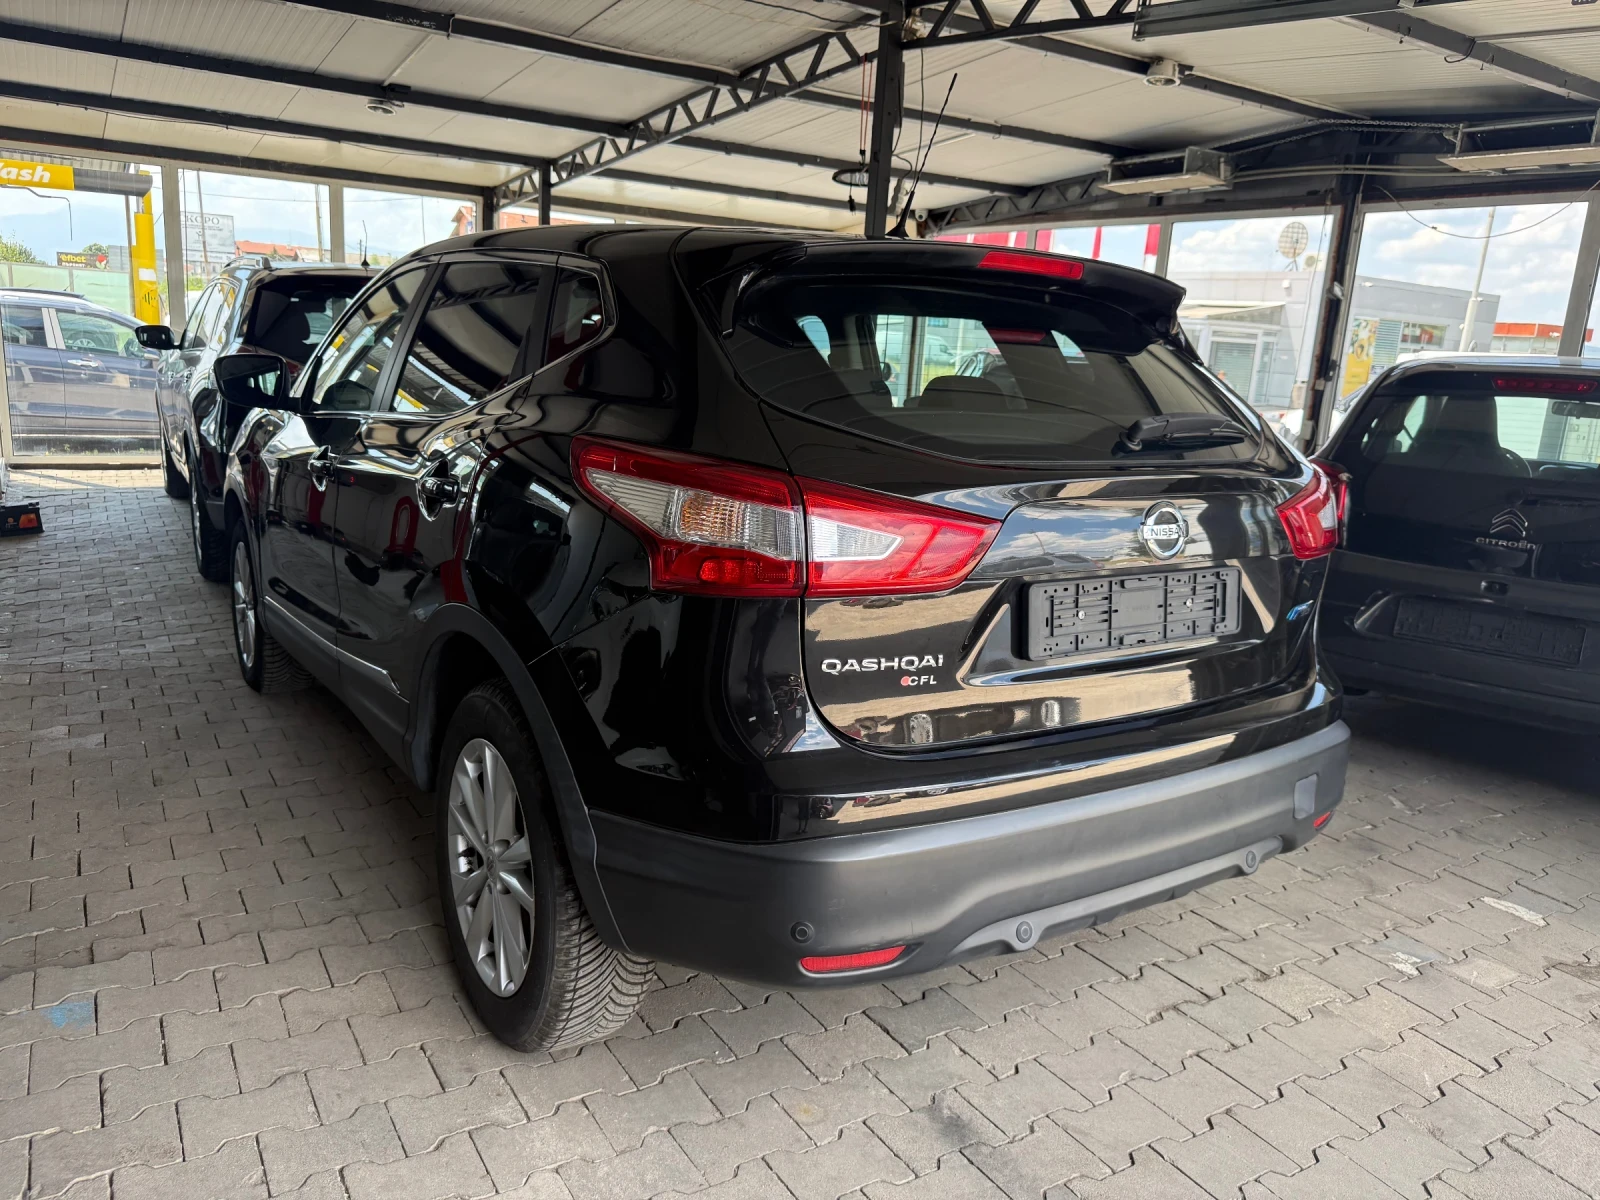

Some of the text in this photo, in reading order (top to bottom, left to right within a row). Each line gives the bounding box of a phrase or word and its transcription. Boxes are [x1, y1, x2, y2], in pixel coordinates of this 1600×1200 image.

[0, 162, 51, 183] ash
[61, 254, 87, 263] efbet
[821, 654, 944, 676] QASHQAI
